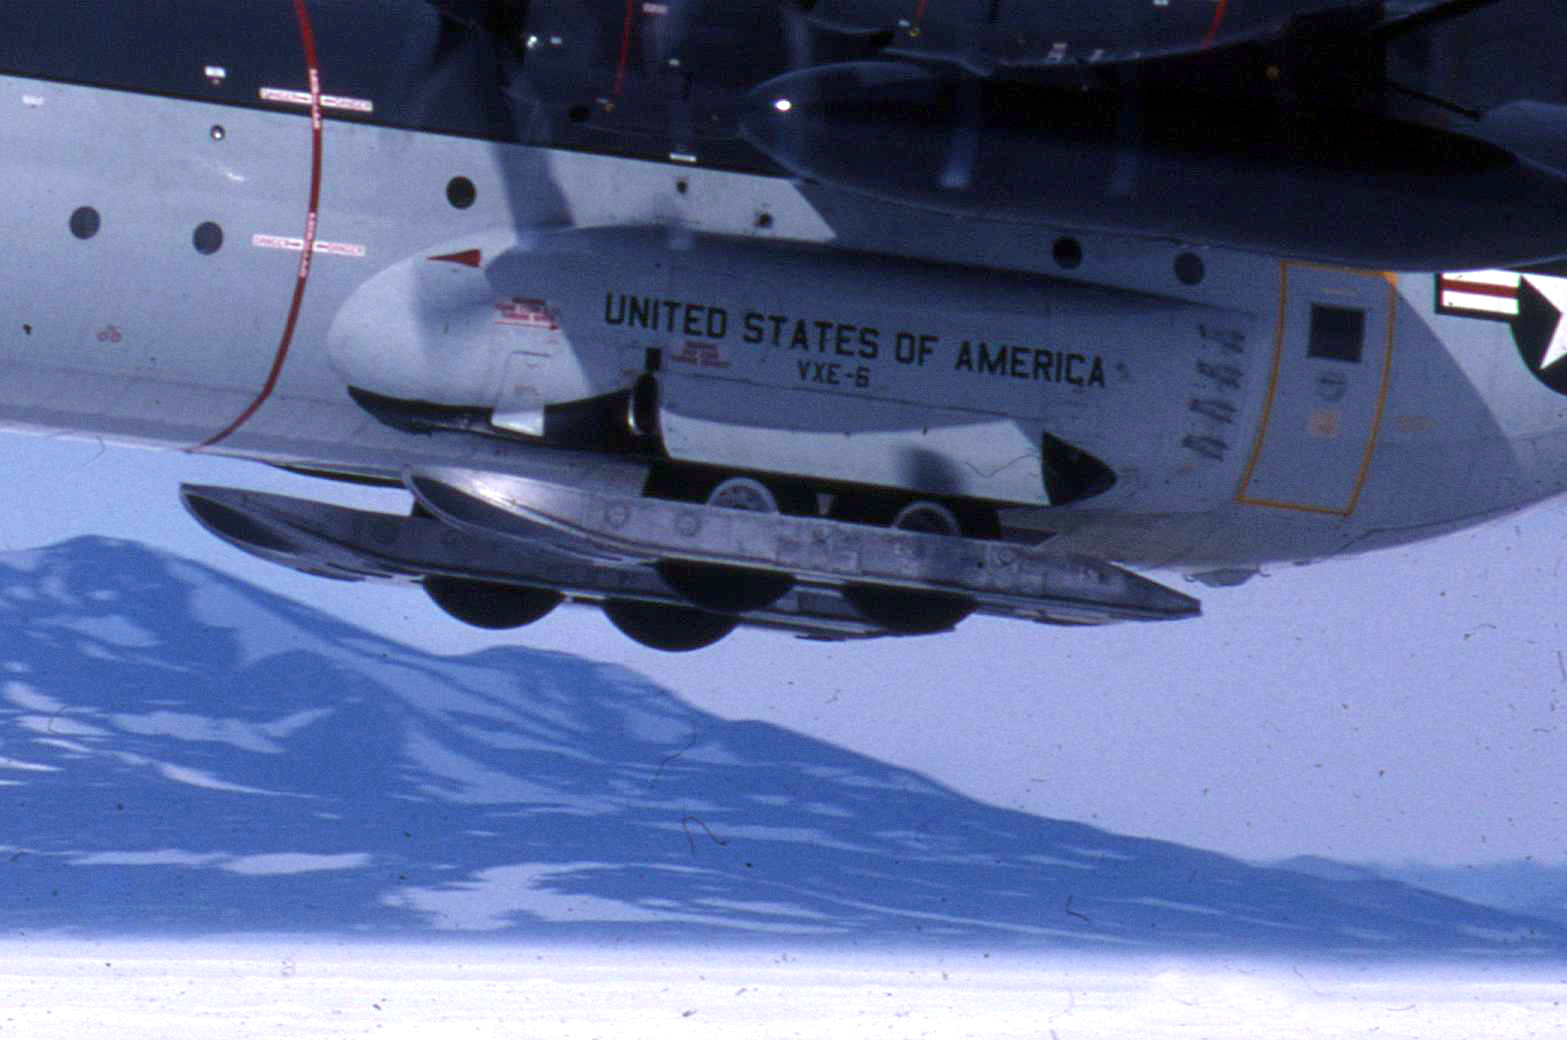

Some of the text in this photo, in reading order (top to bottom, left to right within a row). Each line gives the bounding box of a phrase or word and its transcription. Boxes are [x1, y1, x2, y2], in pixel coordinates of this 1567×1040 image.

[605, 292, 727, 339] UNITED
[743, 310, 880, 360] STATES
[895, 331, 939, 367] OF
[954, 340, 1106, 389] AMERICA
[797, 360, 871, 388] VXE-6
